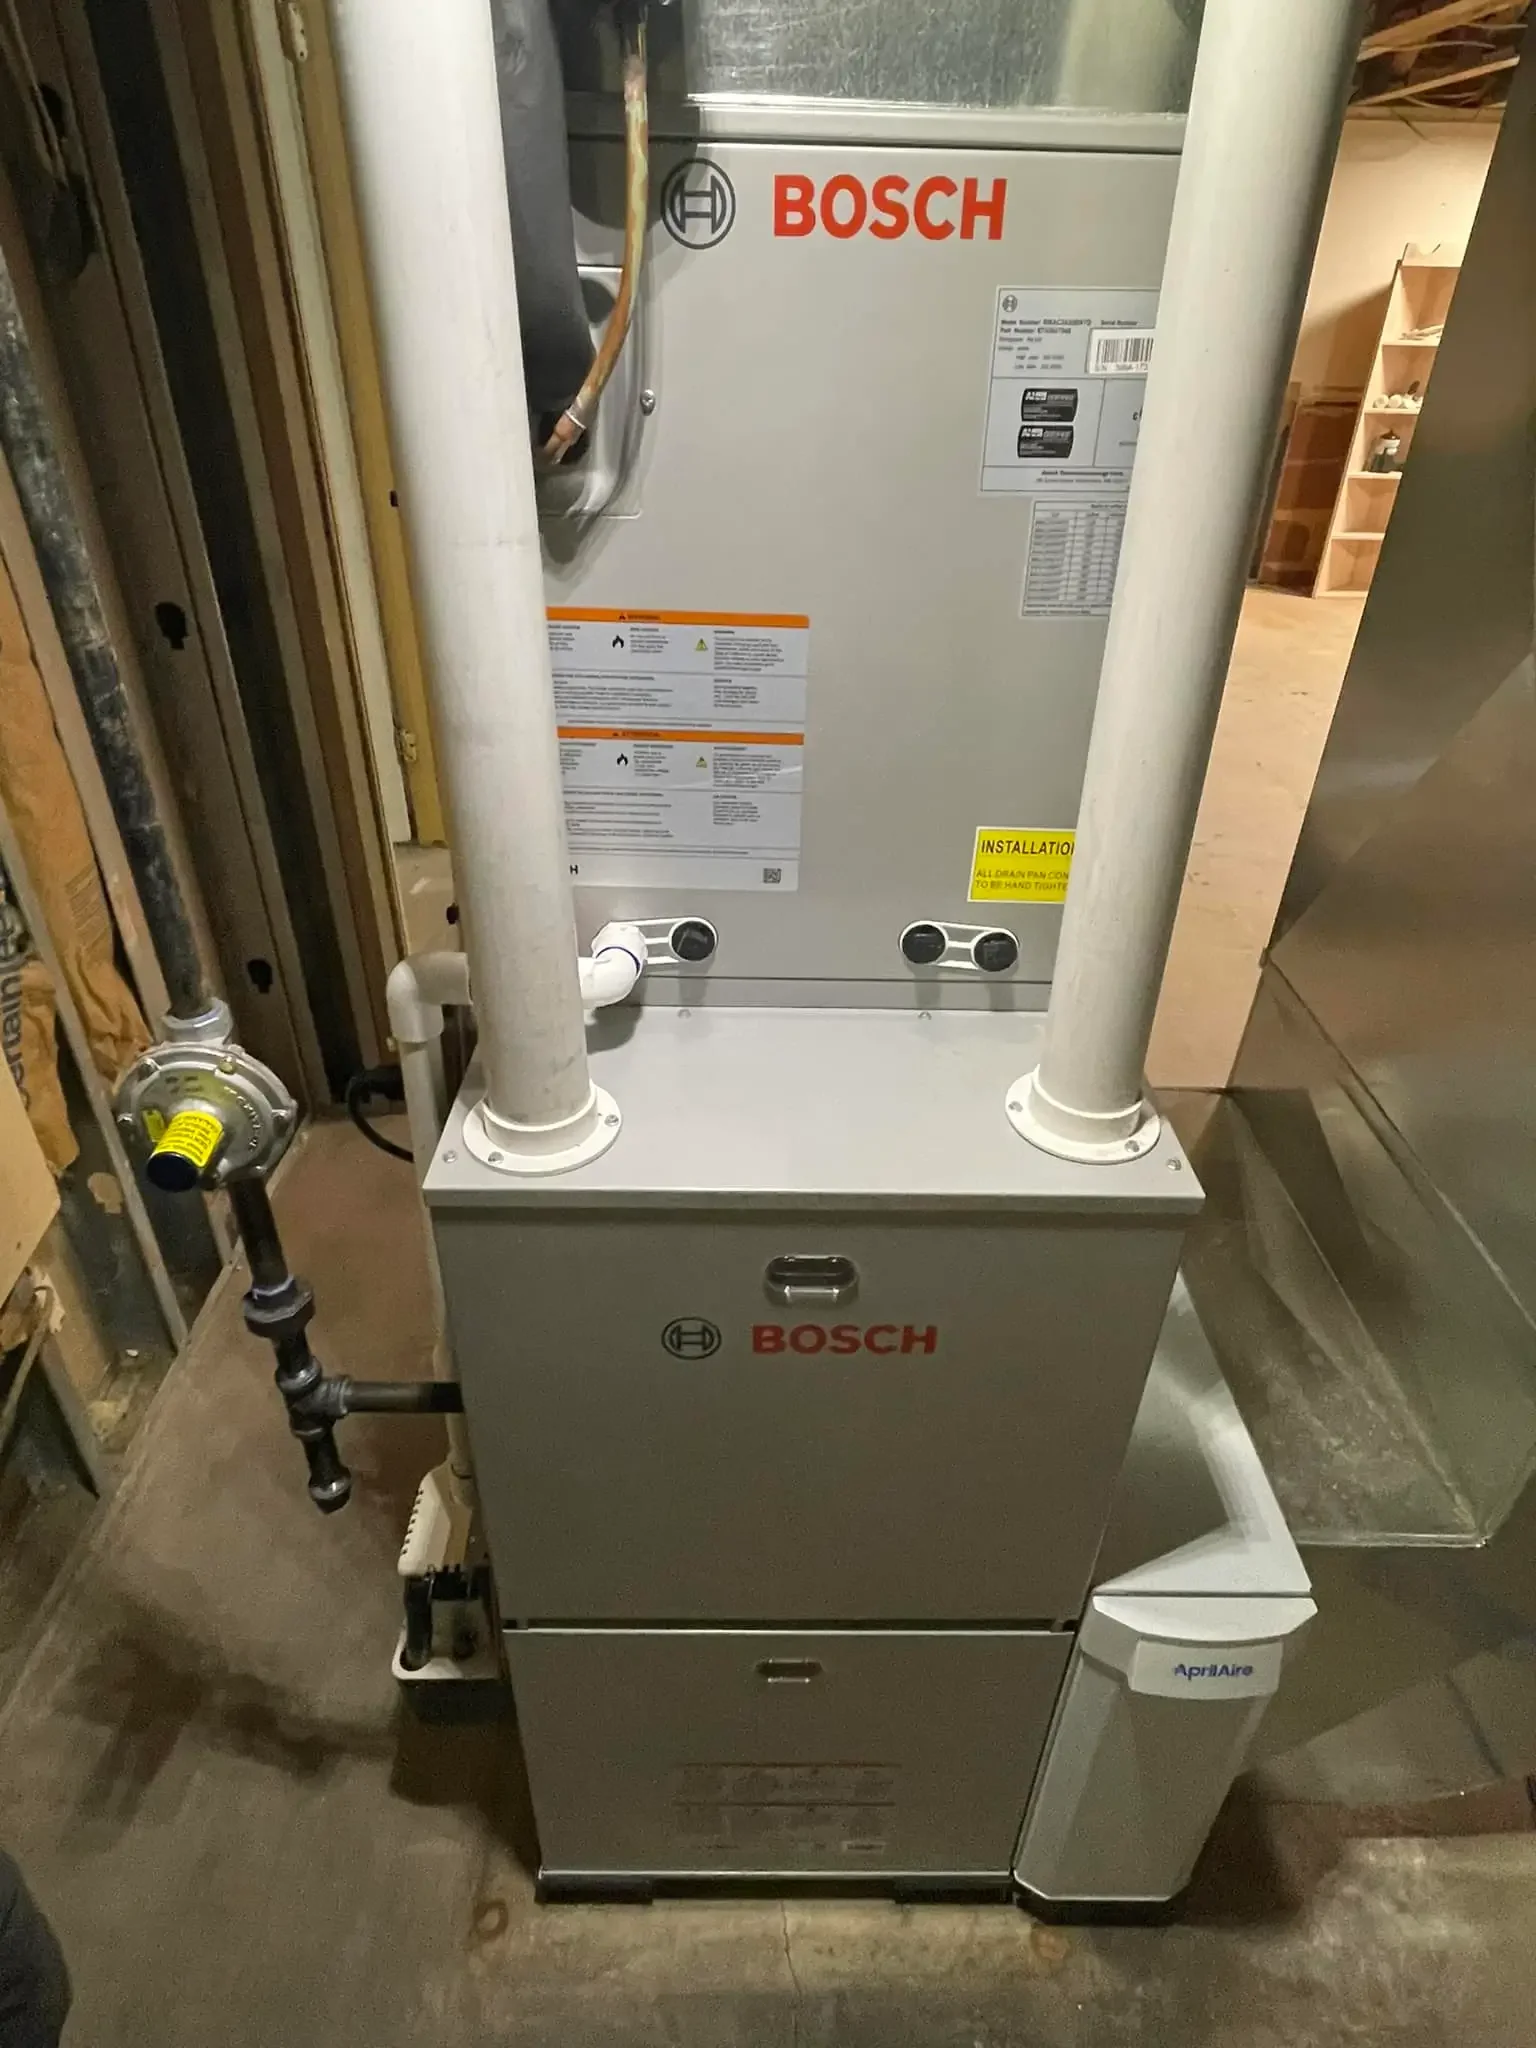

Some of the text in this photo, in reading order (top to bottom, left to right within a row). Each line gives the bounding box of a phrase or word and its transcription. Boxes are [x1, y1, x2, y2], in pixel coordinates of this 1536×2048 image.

[774, 173, 1007, 240] BOSCH
[981, 840, 1074, 855] INSTALLATIO
[976, 869, 992, 879] ALL
[995, 869, 1026, 879] DRAIN
[1027, 870, 1046, 880] PAN
[975, 879, 989, 889] TO
[990, 880, 1003, 889] BE
[1004, 881, 1032, 890] HAND
[752, 1324, 938, 1355] BOSCH
[1174, 1663, 1254, 1681] AprilAire
